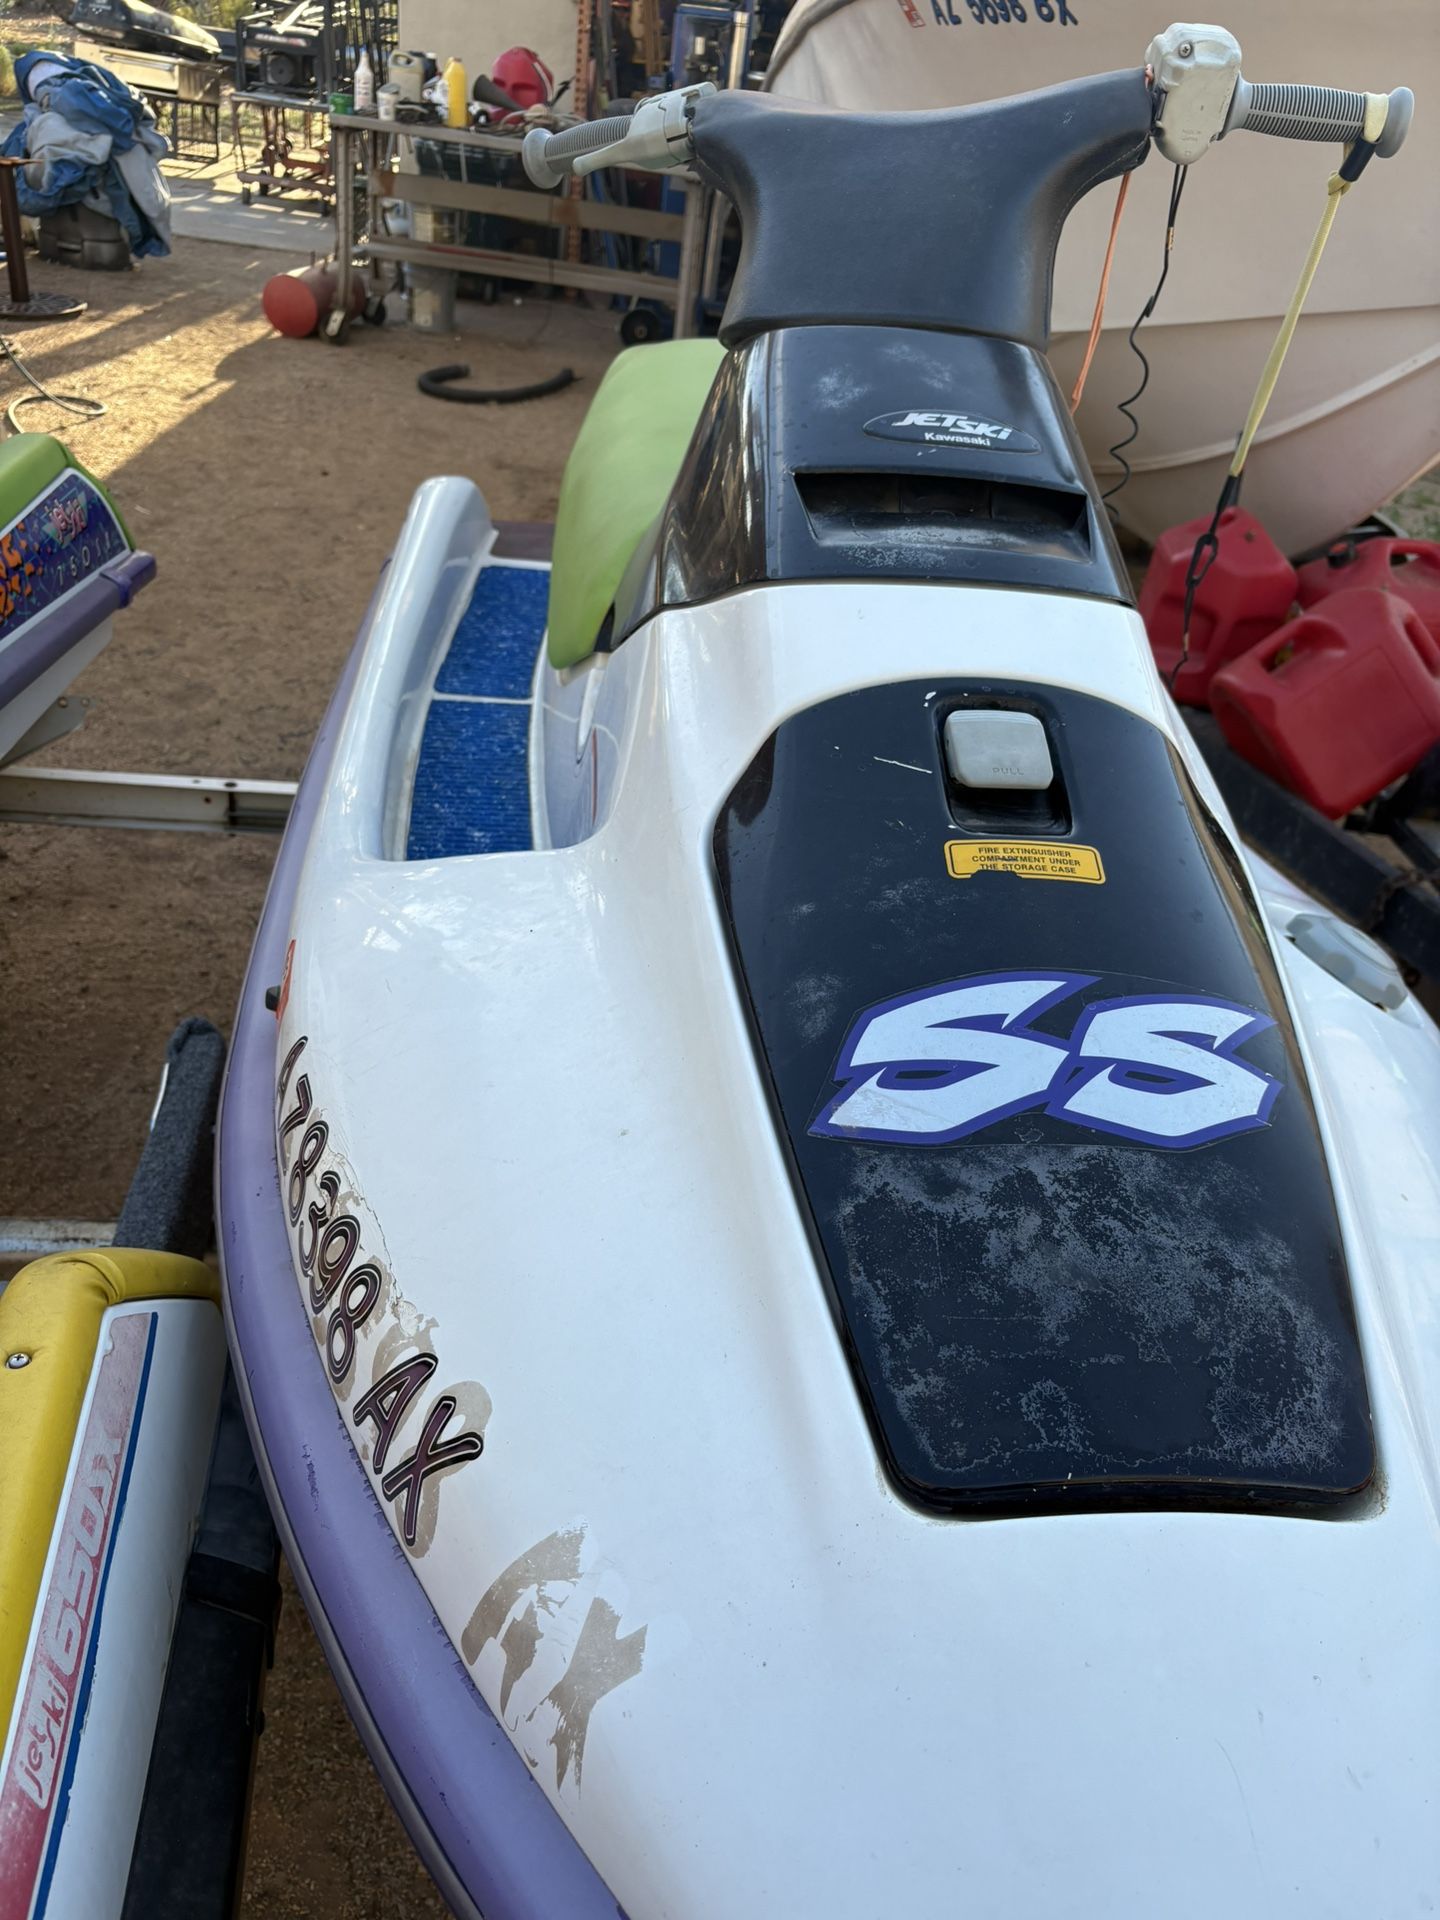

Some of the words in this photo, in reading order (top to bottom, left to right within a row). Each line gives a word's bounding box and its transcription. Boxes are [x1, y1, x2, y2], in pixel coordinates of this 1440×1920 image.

[924, 432, 991, 446] Kawasaki
[992, 766, 1025, 776] PULL
[1003, 847, 1072, 858] EXTINGUISHER
[971, 855, 1046, 864] COMPARTMENT
[1049, 857, 1081, 867] UNDER
[980, 863, 999, 871] THE
[1002, 863, 1049, 872] STORAGE
[1051, 865, 1077, 874] CASE
[352, 1351, 484, 1547] AX
